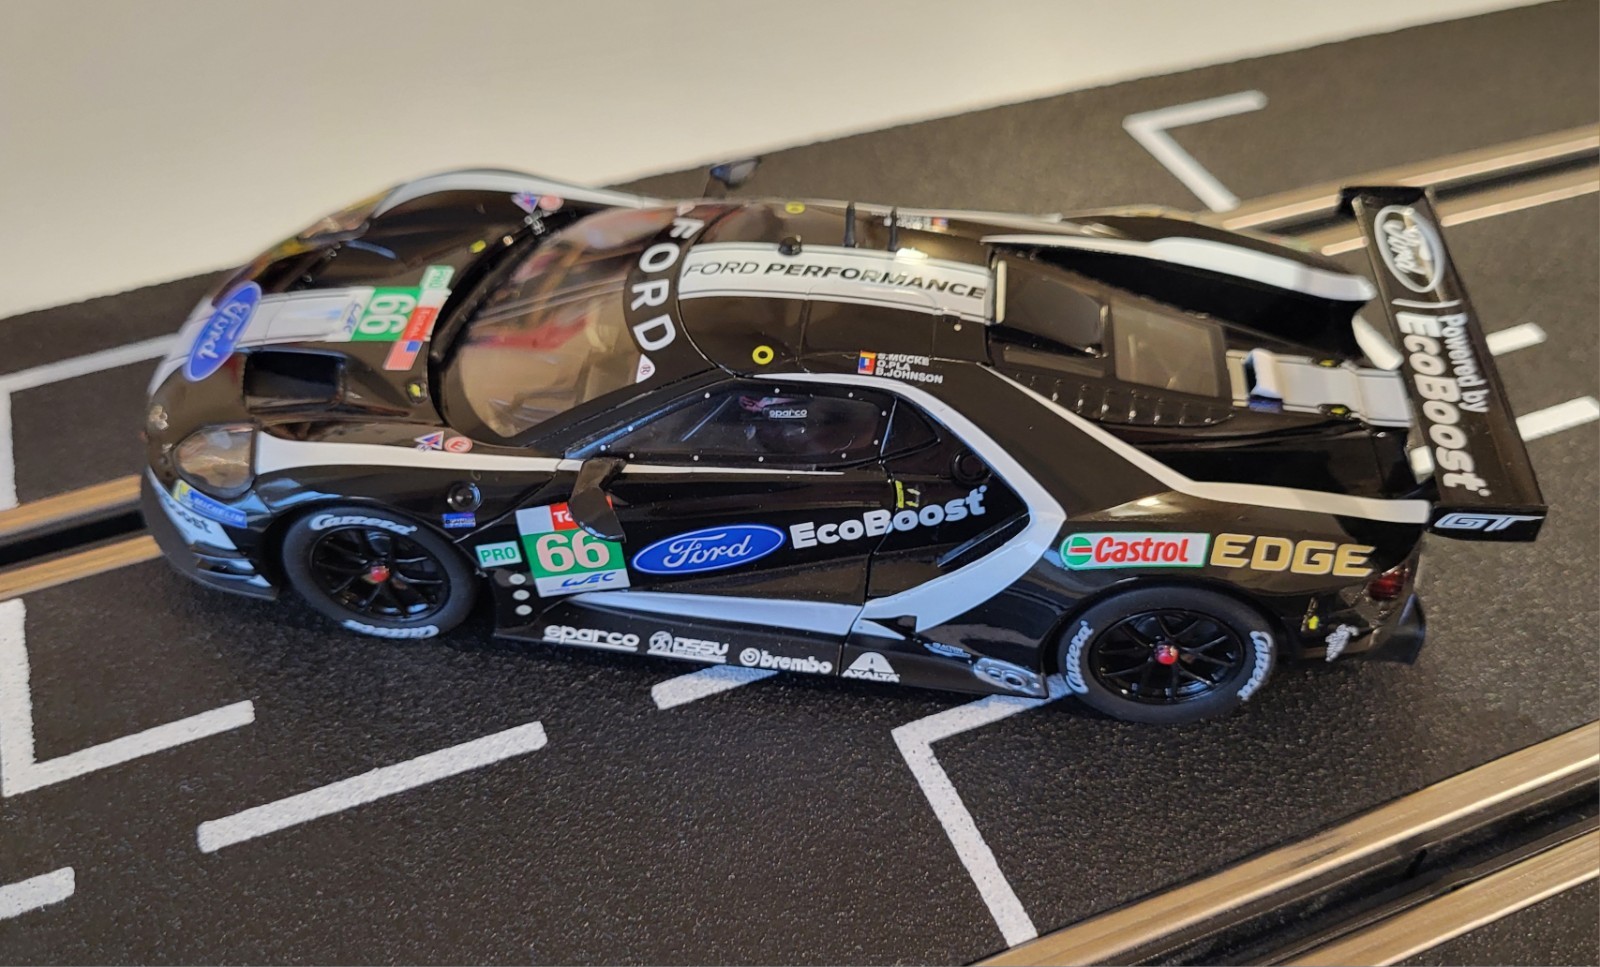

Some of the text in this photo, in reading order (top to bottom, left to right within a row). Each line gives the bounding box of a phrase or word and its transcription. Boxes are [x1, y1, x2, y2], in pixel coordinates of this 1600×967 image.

[631, 217, 704, 351] FORD
[682, 260, 986, 299] FORD PERFORMANCE
[198, 301, 251, 359] Ford
[358, 294, 417, 334] 66
[875, 367, 944, 384] B.JOHNSON
[876, 360, 911, 371] O.PLA
[1437, 312, 1490, 412] Powered by
[1396, 312, 1491, 497] EcoBoost
[309, 513, 418, 536] Carrera
[789, 485, 988, 549] EcoBoost
[1434, 512, 1545, 532] GT
[480, 546, 517, 564] PRO
[536, 530, 610, 572] 66
[663, 532, 753, 568] Ford
[1095, 533, 1376, 577] Castrol EDGE
[561, 572, 617, 587] WEC
[544, 624, 640, 645] sparco
[759, 651, 833, 674] brembo
[841, 668, 900, 683] AXALTA
